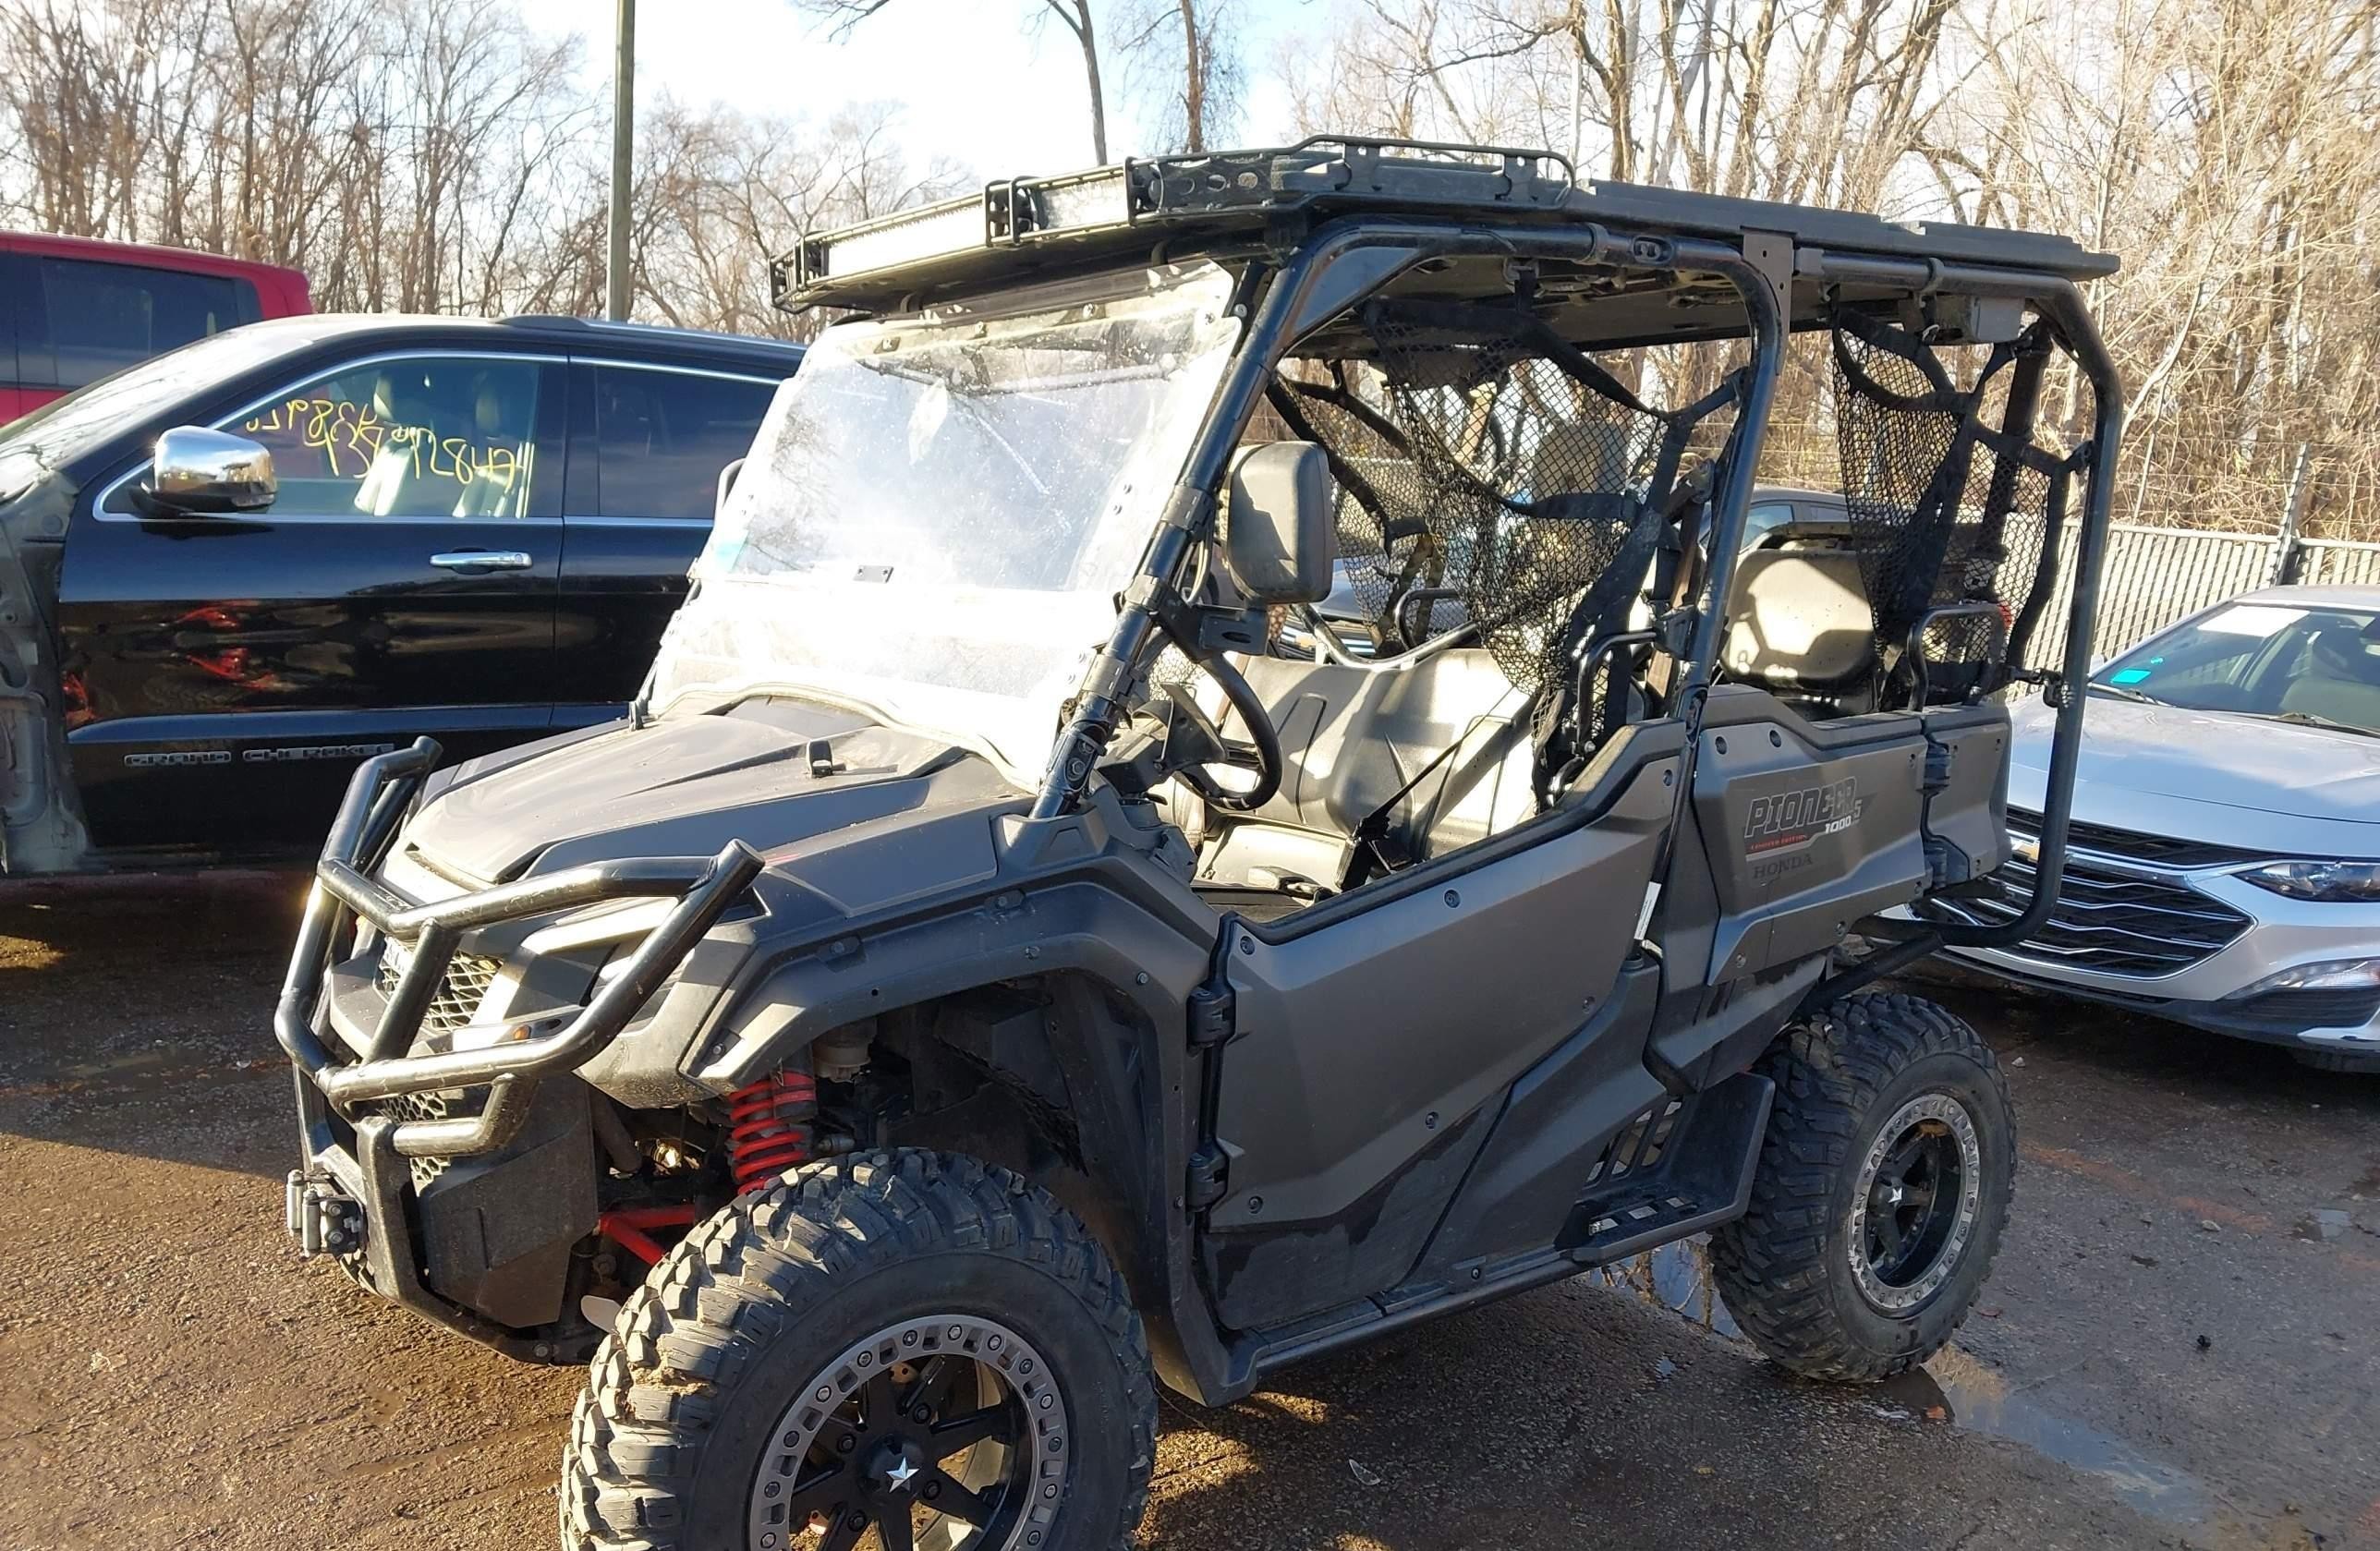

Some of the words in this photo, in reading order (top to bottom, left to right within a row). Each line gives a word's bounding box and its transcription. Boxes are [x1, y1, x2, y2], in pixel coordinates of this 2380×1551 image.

[124, 751, 231, 768] GRAND
[1744, 776, 1857, 839] PIONEER
[1825, 816, 1852, 834] 1000
[1754, 854, 1814, 878] HONDA
